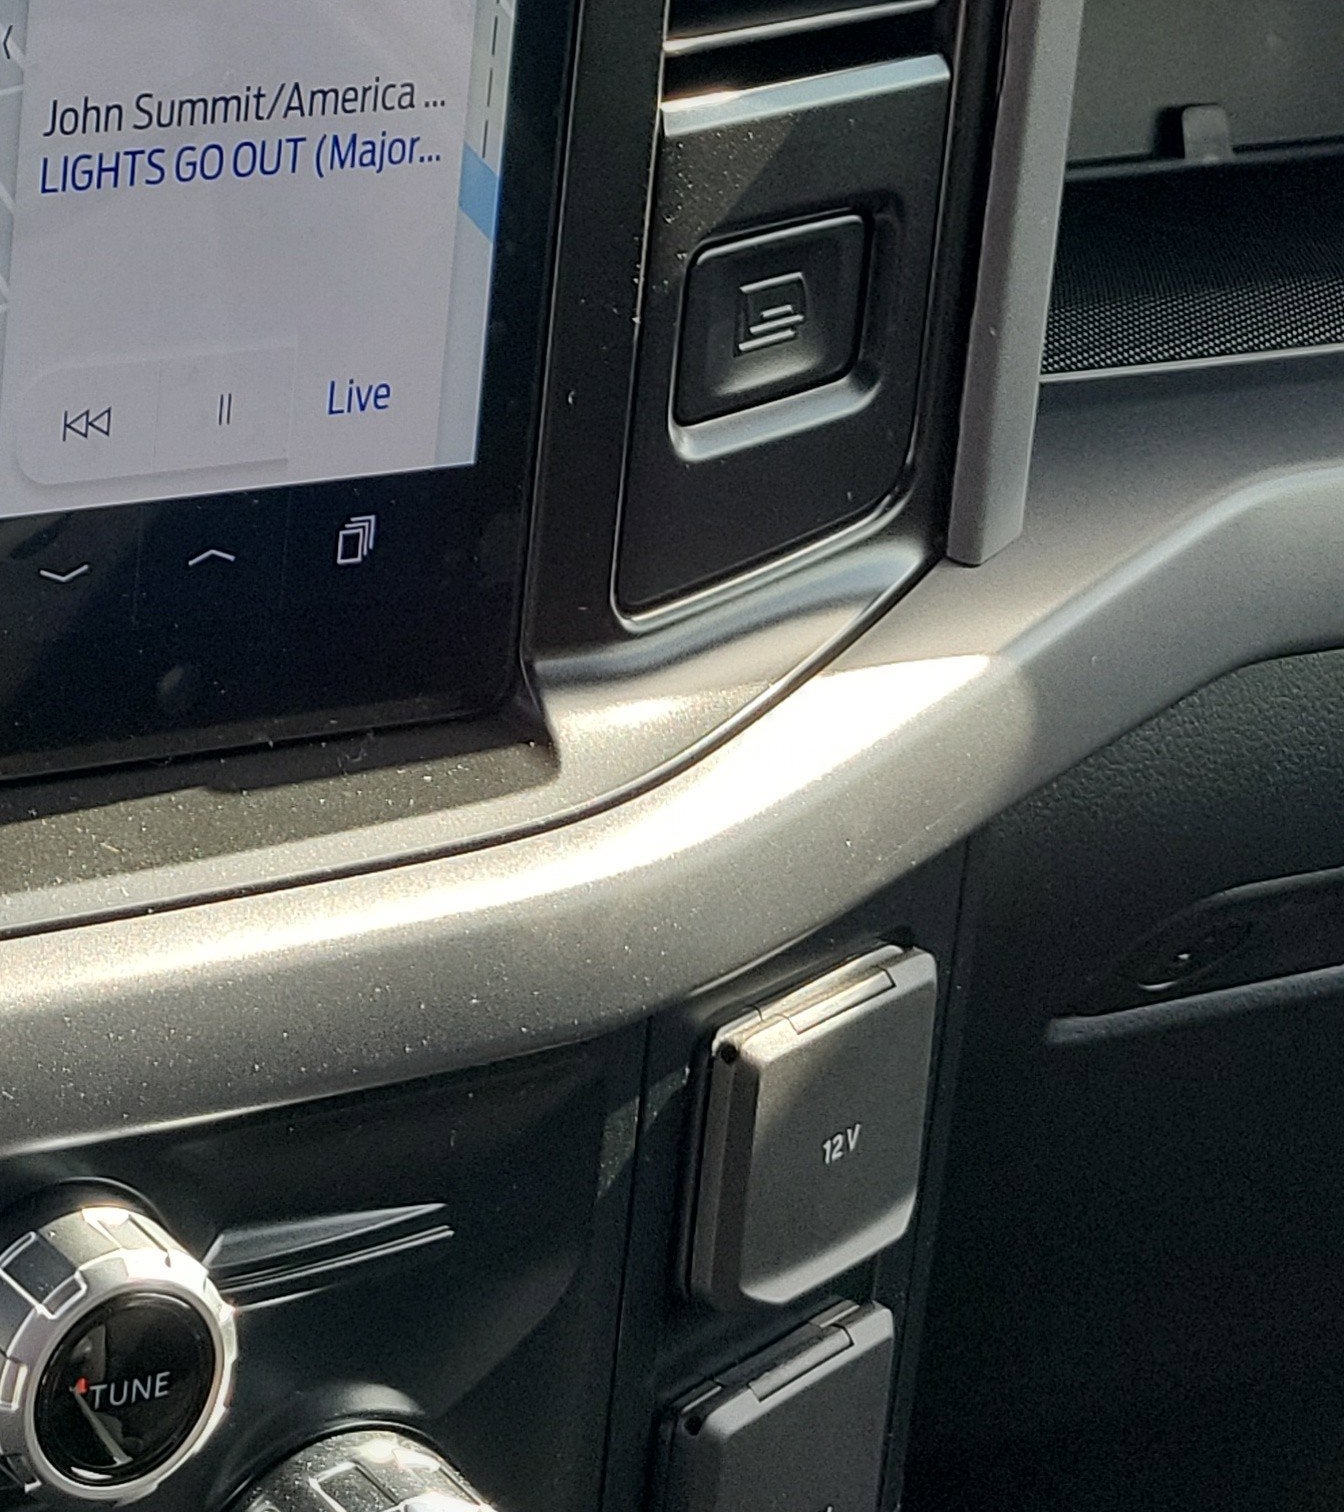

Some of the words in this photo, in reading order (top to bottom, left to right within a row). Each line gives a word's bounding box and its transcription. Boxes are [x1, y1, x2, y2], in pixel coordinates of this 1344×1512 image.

[43, 97, 123, 137] John
[133, 77, 416, 130] Summit/America
[40, 148, 165, 194] LIGHTS
[175, 143, 224, 183] GO
[233, 137, 306, 177] OUT
[327, 379, 391, 415] Live
[89, 1372, 170, 1409] TUNE
